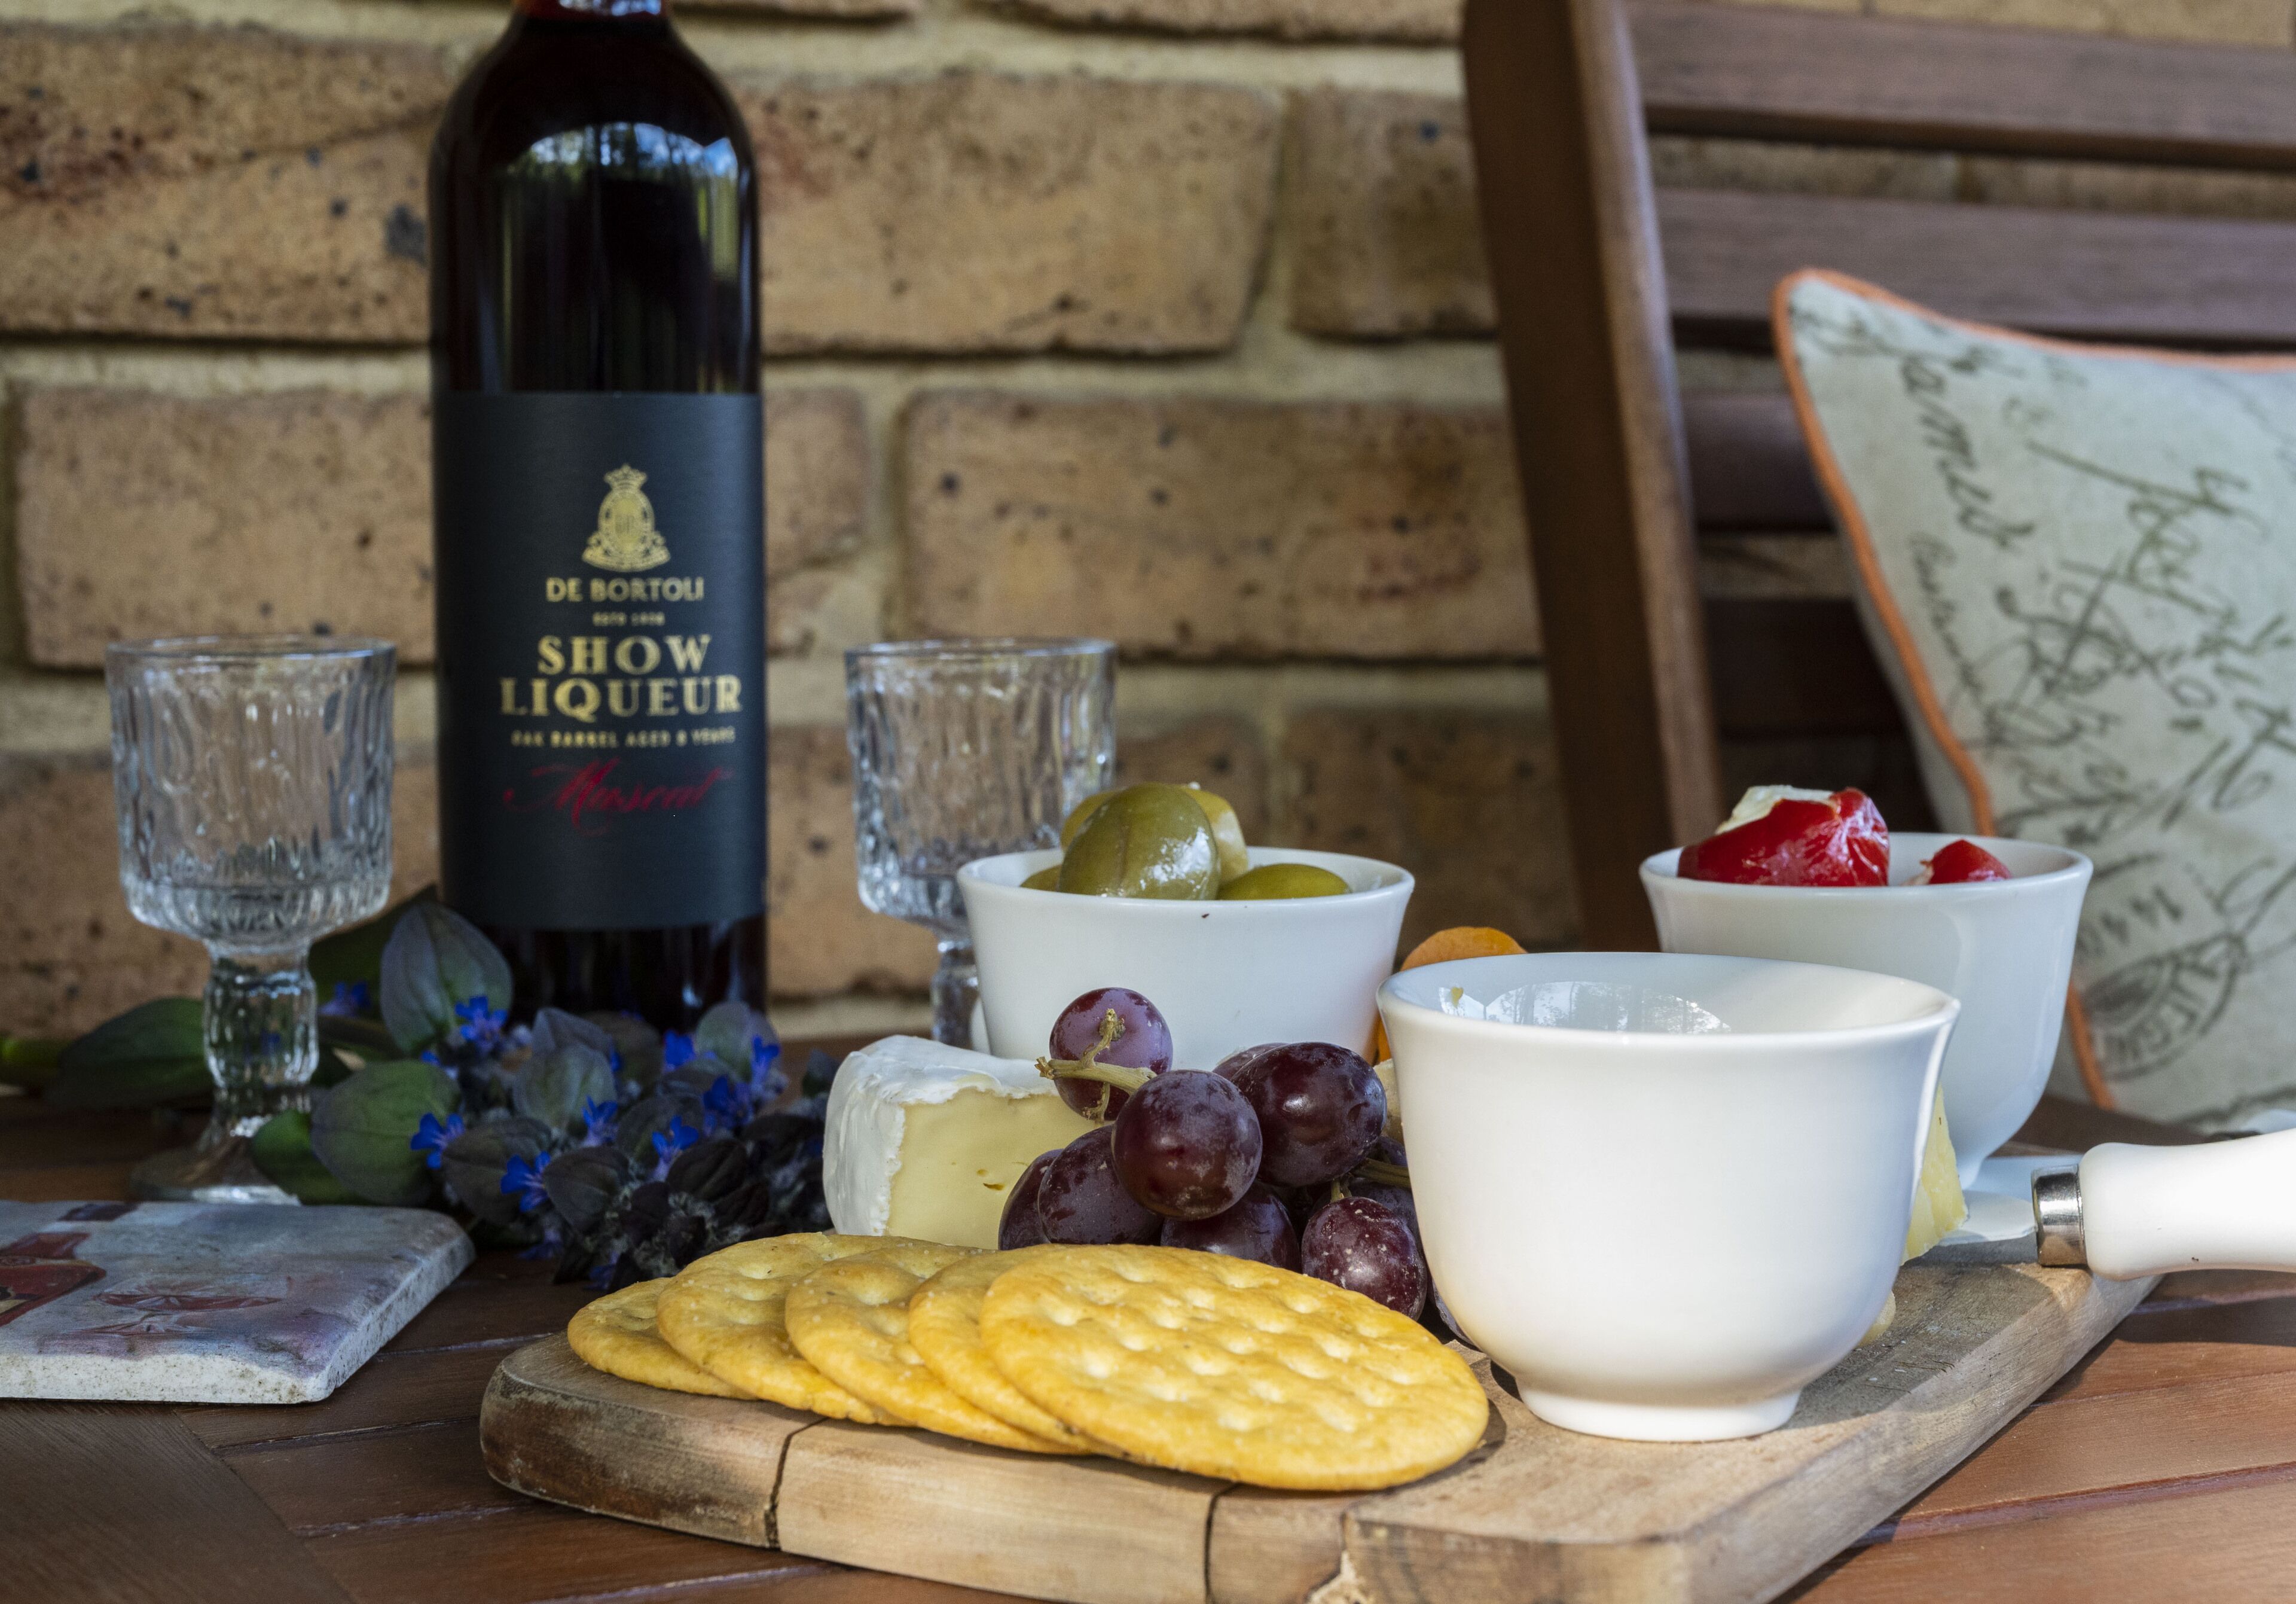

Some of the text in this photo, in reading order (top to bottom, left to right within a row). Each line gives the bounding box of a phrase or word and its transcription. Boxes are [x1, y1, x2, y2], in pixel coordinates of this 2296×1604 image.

[546, 577, 704, 602] DE BORTOLI
[538, 635, 712, 675] SHOW
[500, 675, 742, 723] LIQUEUR
[550, 730, 618, 748] BARREL
[625, 730, 671, 748] AGED
